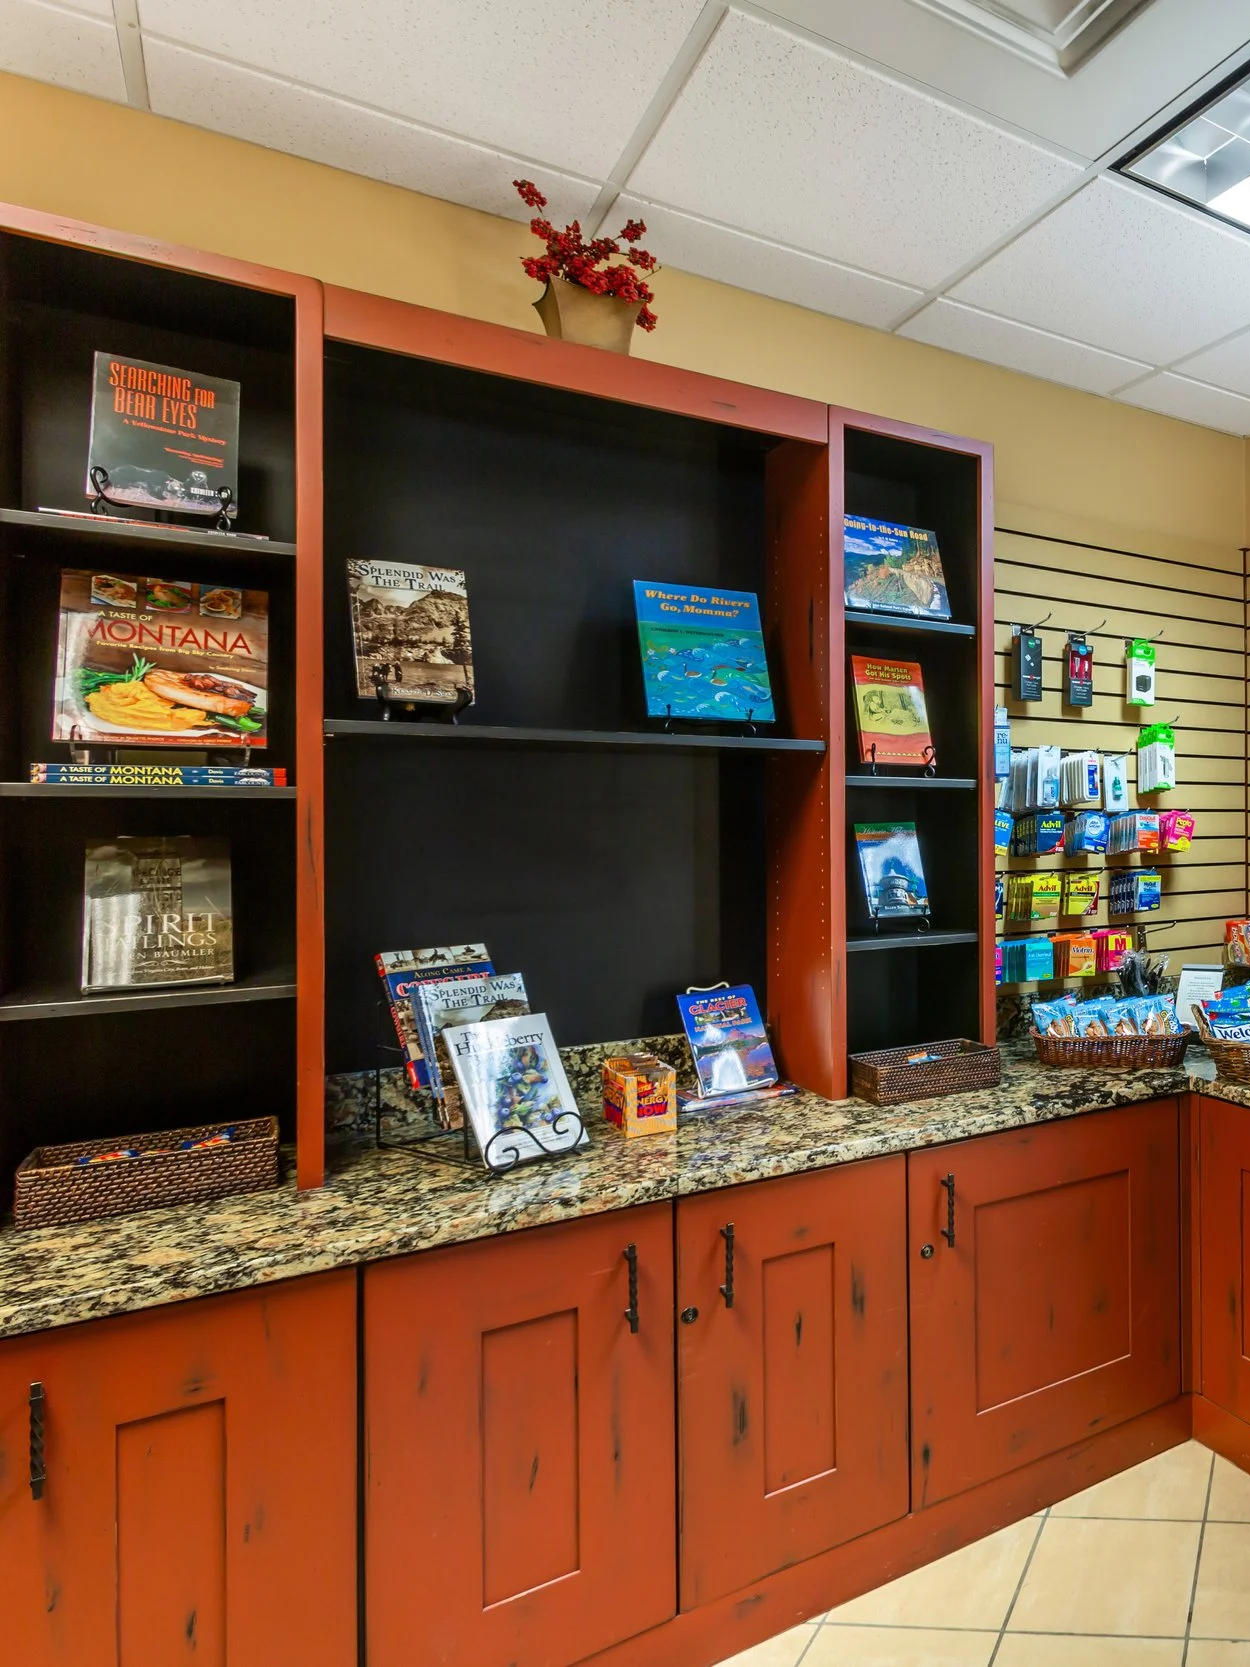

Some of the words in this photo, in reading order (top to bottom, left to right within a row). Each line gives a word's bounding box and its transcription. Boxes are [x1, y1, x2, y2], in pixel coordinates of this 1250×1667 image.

[109, 361, 191, 402] SEARCHING
[194, 388, 215, 409] FOR
[114, 387, 156, 420] BEAR
[162, 397, 197, 429] EYES
[132, 420, 177, 435] Yellowstone
[178, 430, 196, 440] Park
[844, 518, 908, 538] Going-to-the-Sun
[910, 530, 928, 541] Road
[358, 564, 424, 579] SPLENDID
[428, 572, 456, 583] WAS
[372, 575, 400, 587] THE
[405, 579, 445, 592] TRAIL
[645, 589, 687, 602] Where
[690, 595, 707, 604] Do
[711, 597, 751, 608] Rivers
[108, 611, 137, 620] TASTE
[139, 614, 153, 622] OF
[660, 602, 681, 613] Go,
[683, 606, 740, 618] Momma?
[81, 618, 252, 655] MONTANA
[96, 640, 127, 648] Favorite
[129, 643, 157, 652] Recipes
[159, 645, 176, 653] from
[178, 647, 190, 655] Big
[206, 651, 235, 660] Country
[867, 663, 882, 671] How
[95, 766, 107, 774] OF
[109, 766, 183, 776] MONTANA
[109, 776, 183, 785] MONTANA
[995, 819, 1009, 829] LEVE
[1041, 820, 1061, 829] Advil
[154, 949, 215, 958] BAUMLER
[414, 970, 441, 979] ALONG
[442, 967, 464, 976] CAME
[429, 984, 487, 1001] SPLENDID
[489, 981, 515, 992] WAS
[441, 998, 468, 1008] THE
[471, 993, 509, 1006] TRAIL
[689, 998, 747, 1015] GLACIER
